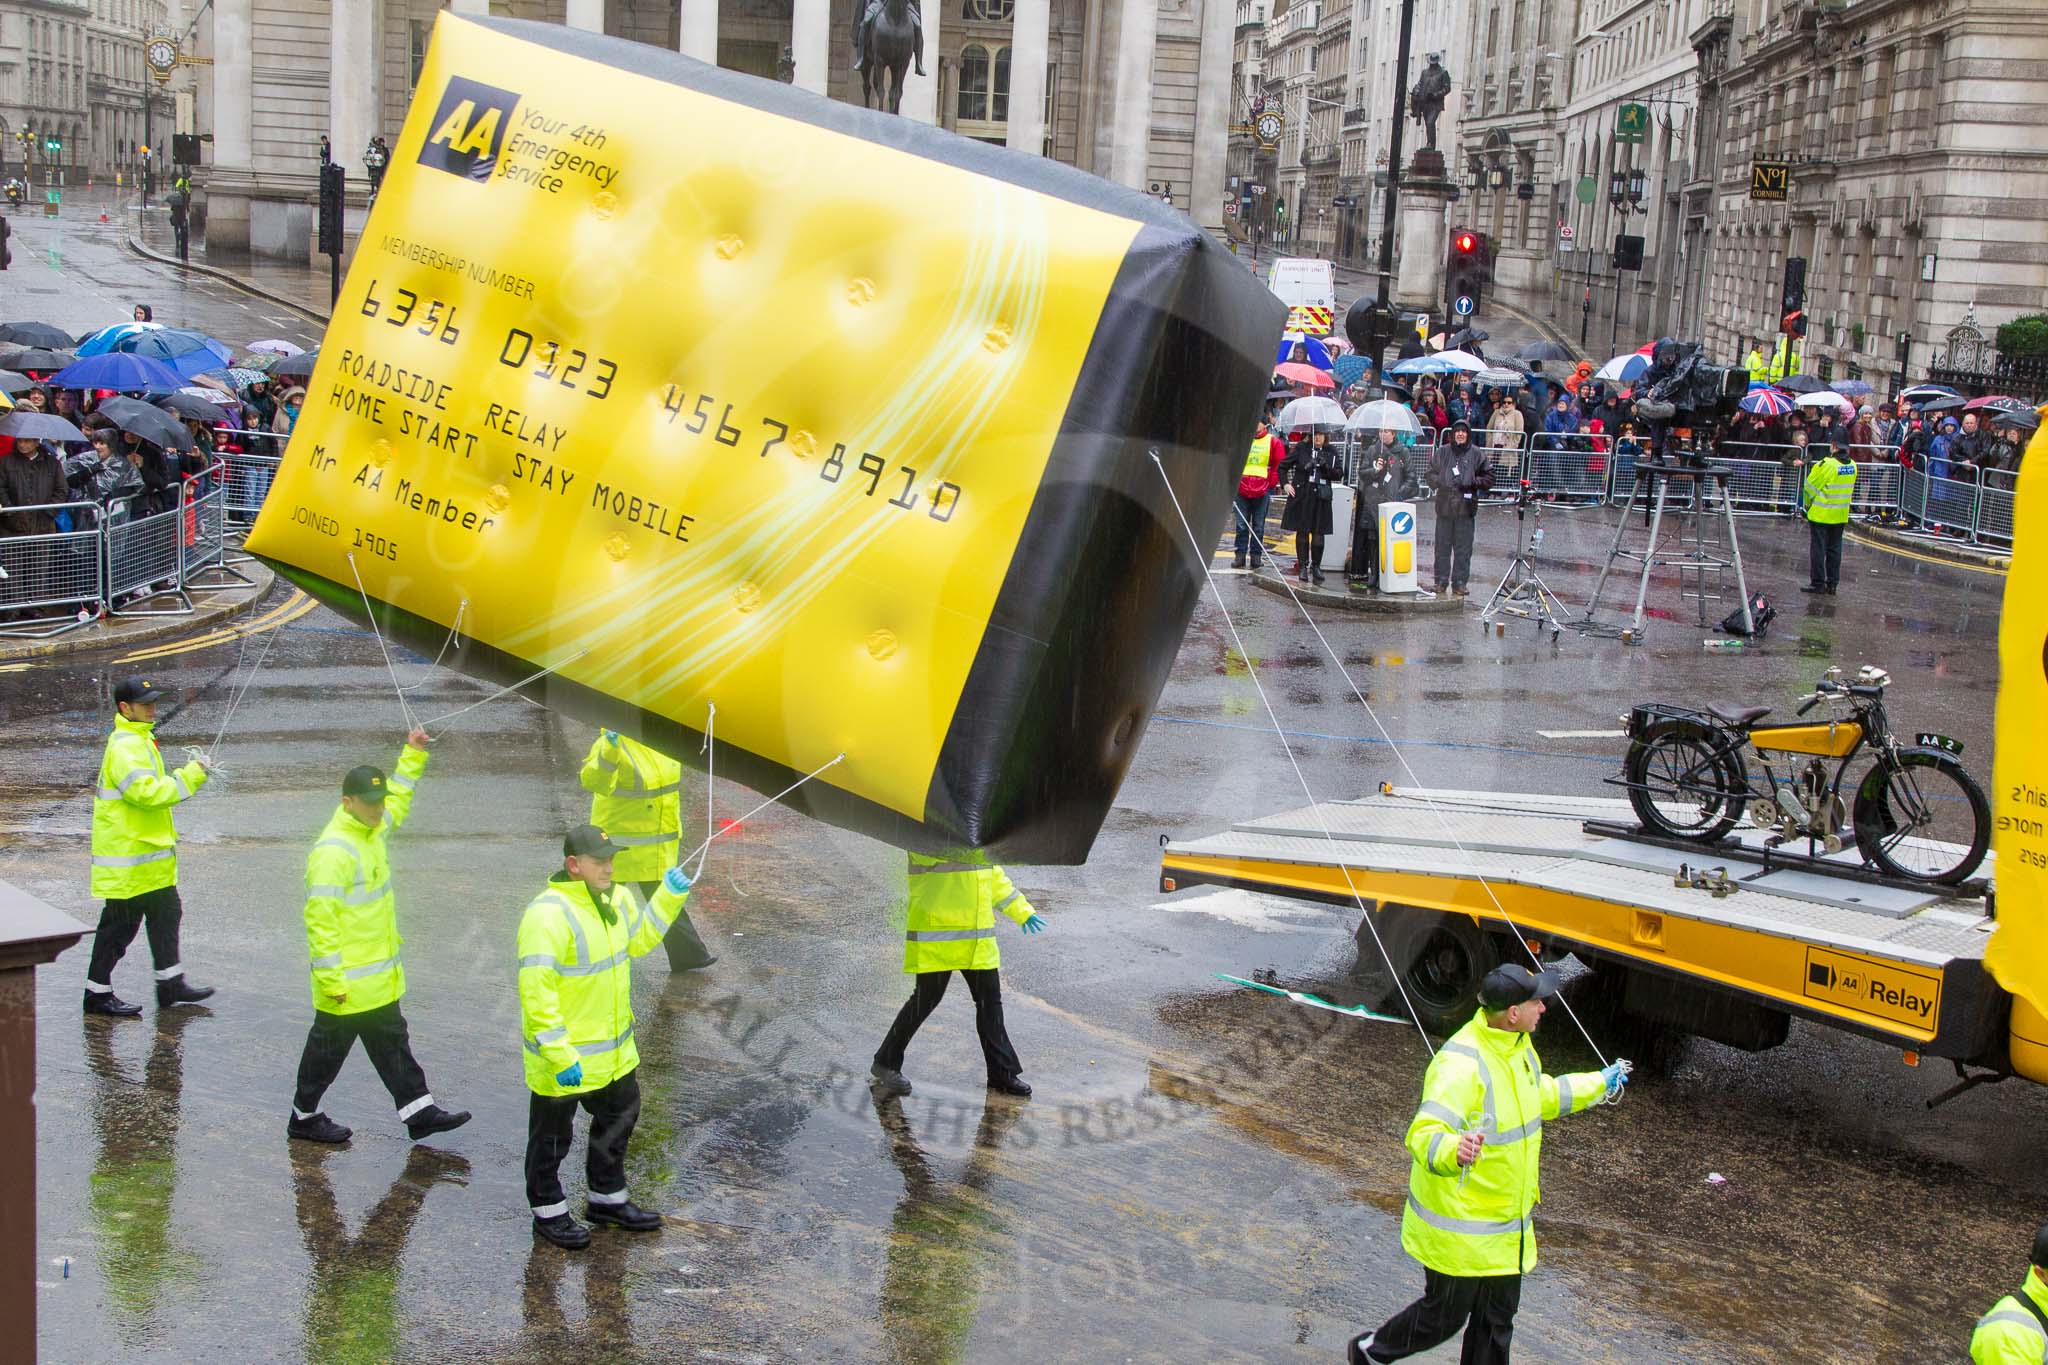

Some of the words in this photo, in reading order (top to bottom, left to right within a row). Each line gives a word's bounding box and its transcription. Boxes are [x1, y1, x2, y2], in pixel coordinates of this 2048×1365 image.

[430, 99, 502, 160] AA
[521, 107, 567, 136] Your
[571, 122, 608, 149] 4th
[497, 159, 565, 194] Service
[507, 133, 619, 188] Emergency
[1752, 190, 1786, 198] CORNHILL
[380, 235, 466, 274] MEMBERSHIP
[467, 262, 535, 300] NUMBER
[339, 349, 453, 410] ROADSIDE
[485, 405, 567, 452] RELAY
[361, 280, 460, 346] 6356
[499, 328, 618, 400] 0123
[664, 386, 789, 458] 4567
[820, 443, 961, 523] 8910
[309, 445, 337, 473] Mr
[353, 463, 382, 491] AA
[394, 479, 496, 533] Member
[329, 384, 384, 426] HOME
[399, 410, 479, 459] START
[511, 452, 575, 496] STAY
[591, 483, 696, 542] MOBILE
[290, 505, 340, 538] JOINED
[352, 528, 398, 561] 1905
[1921, 735, 1940, 746] AA
[1946, 740, 1955, 750] 2
[1842, 977, 1858, 990] AA
[1870, 980, 1933, 1017] Relay
